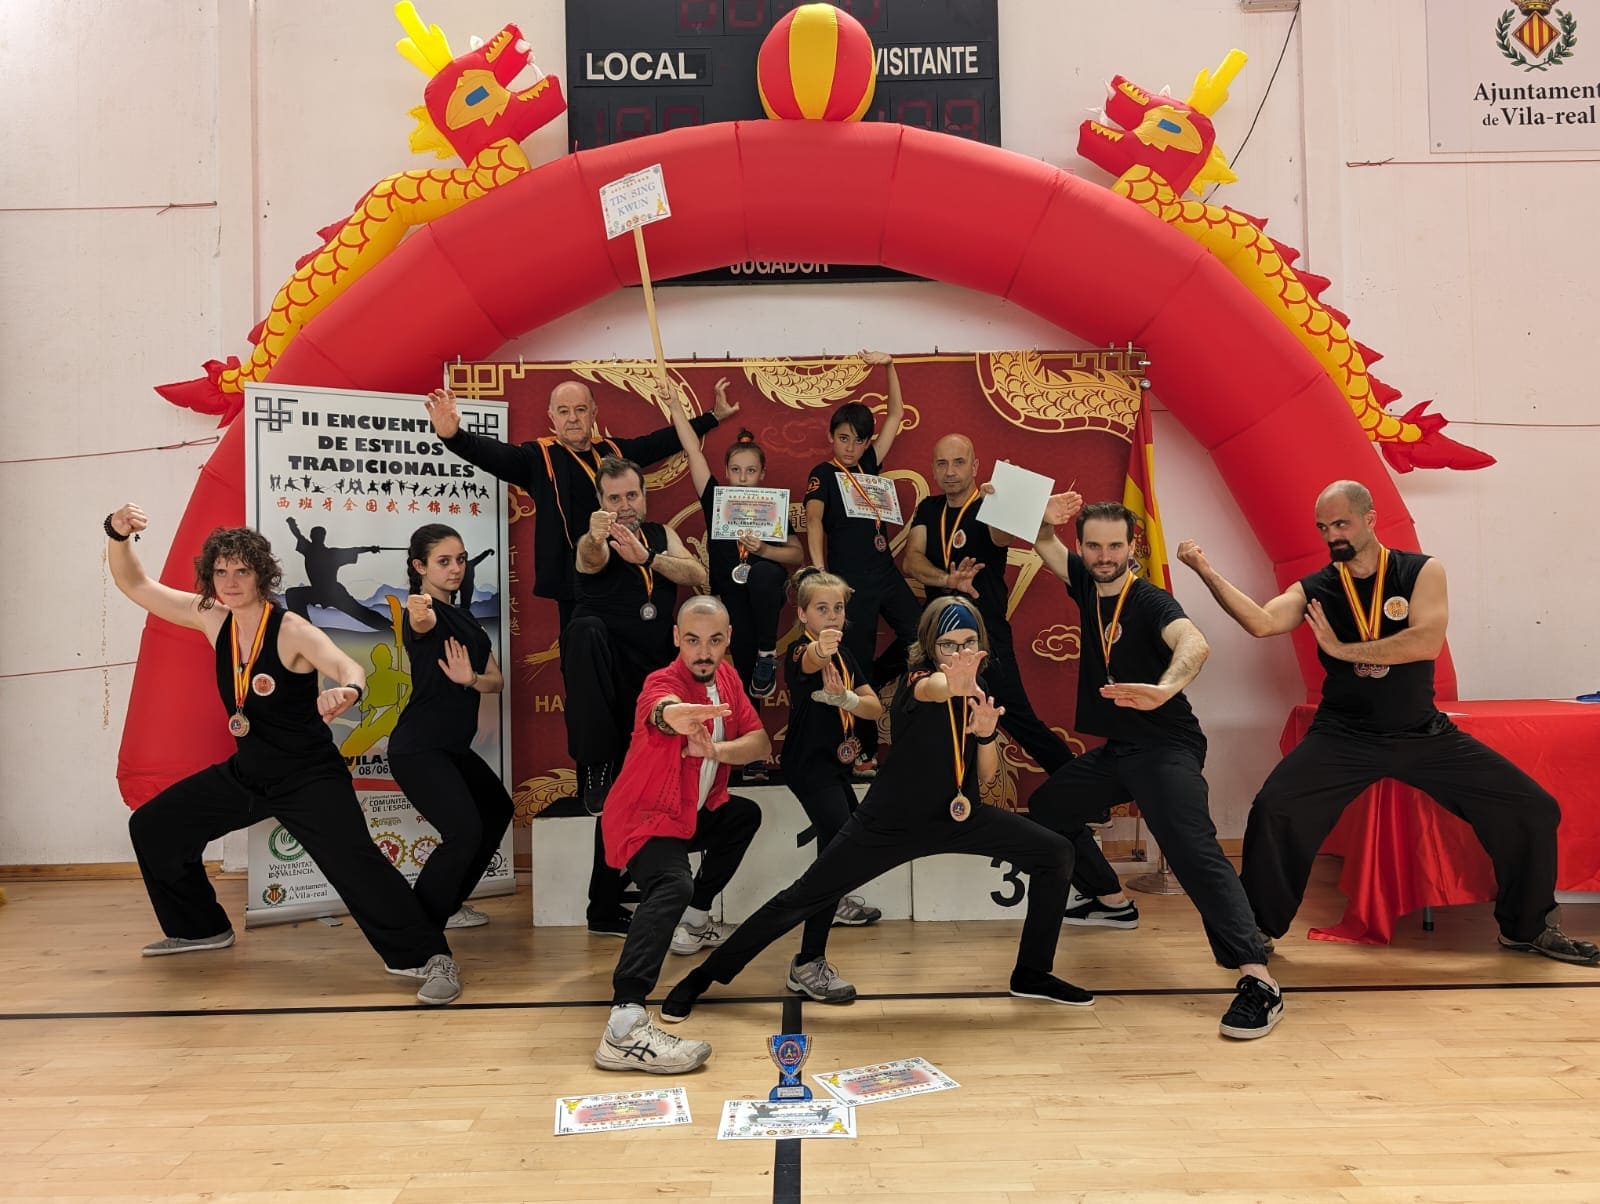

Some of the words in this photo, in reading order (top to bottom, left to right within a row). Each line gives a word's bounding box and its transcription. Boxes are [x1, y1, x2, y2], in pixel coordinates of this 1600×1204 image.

[586, 51, 697, 80] LOCAL
[876, 45, 979, 76] VISITANTE
[1473, 82, 1600, 106] Ajuntament
[1482, 113, 1499, 126] de
[1500, 105, 1597, 126] Vila-real
[617, 196, 649, 217] KWUN
[302, 411, 319, 426] II
[327, 413, 436, 433] ENCUENT
[318, 435, 348, 451] DE
[355, 437, 445, 456] ESTILOS
[288, 455, 475, 478] TRADICIONALES
[990, 857, 1026, 908] 3
[295, 890, 328, 899] Vila-real
